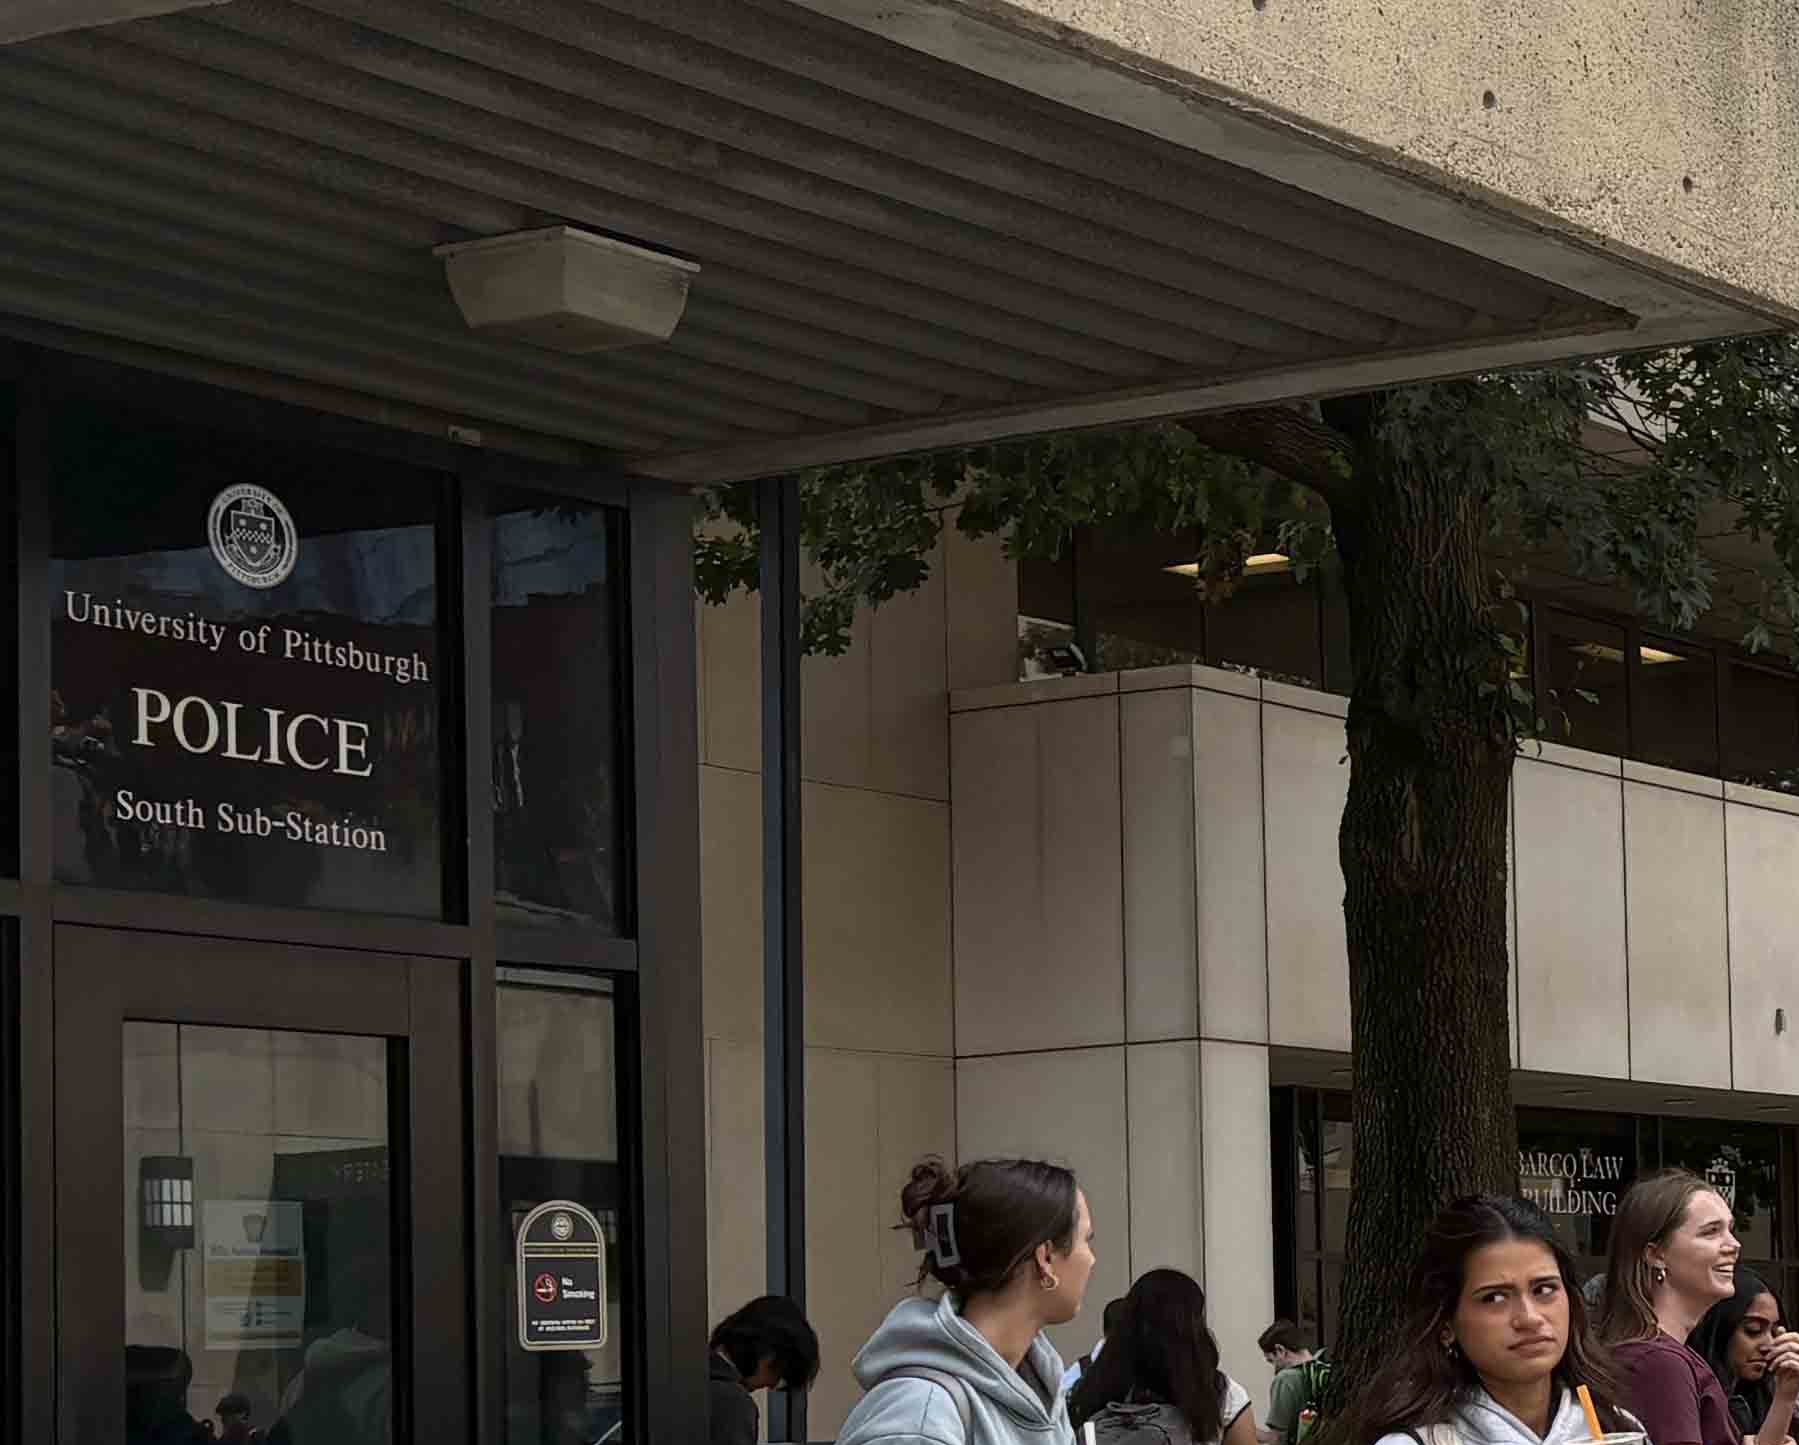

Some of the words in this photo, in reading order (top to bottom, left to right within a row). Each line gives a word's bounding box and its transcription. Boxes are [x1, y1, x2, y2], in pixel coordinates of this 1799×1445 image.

[65, 591, 226, 651] University
[239, 625, 271, 654] of
[283, 628, 429, 684] Pittsburgh
[131, 687, 373, 777] POLICE
[116, 790, 206, 829] South
[217, 803, 387, 851] Sub-Station
[1583, 1156, 1623, 1179] LAW
